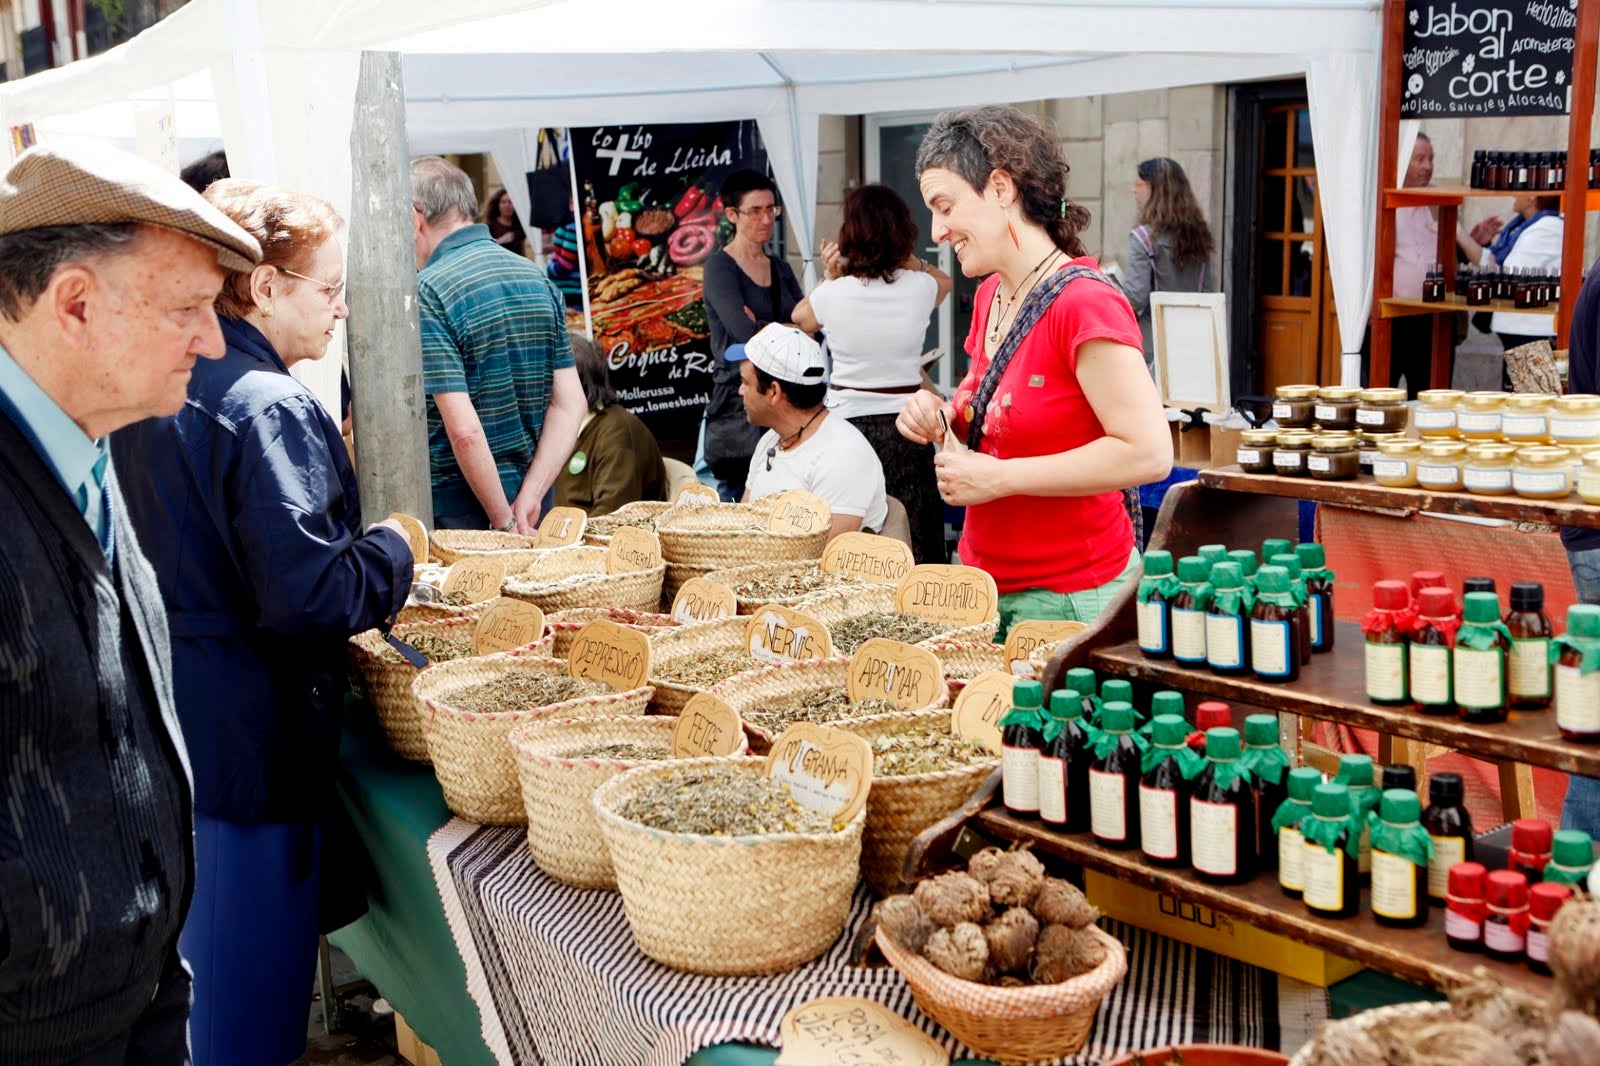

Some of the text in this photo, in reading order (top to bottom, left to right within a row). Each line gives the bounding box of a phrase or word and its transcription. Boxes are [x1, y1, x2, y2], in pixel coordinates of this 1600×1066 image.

[1414, 2, 1513, 37] Jabon
[1479, 27, 1506, 59] al
[1449, 60, 1548, 99] corte
[1449, 99, 1494, 113] Salvaje
[1497, 99, 1505, 112] y
[1508, 92, 1563, 110] Alocado
[633, 145, 733, 177] de Lleida
[608, 341, 679, 377] Coques
[668, 364, 682, 380] de
[616, 386, 675, 401] Mollerussa
[859, 657, 922, 703] APRIMAR
[688, 712, 723, 756] FETGE
